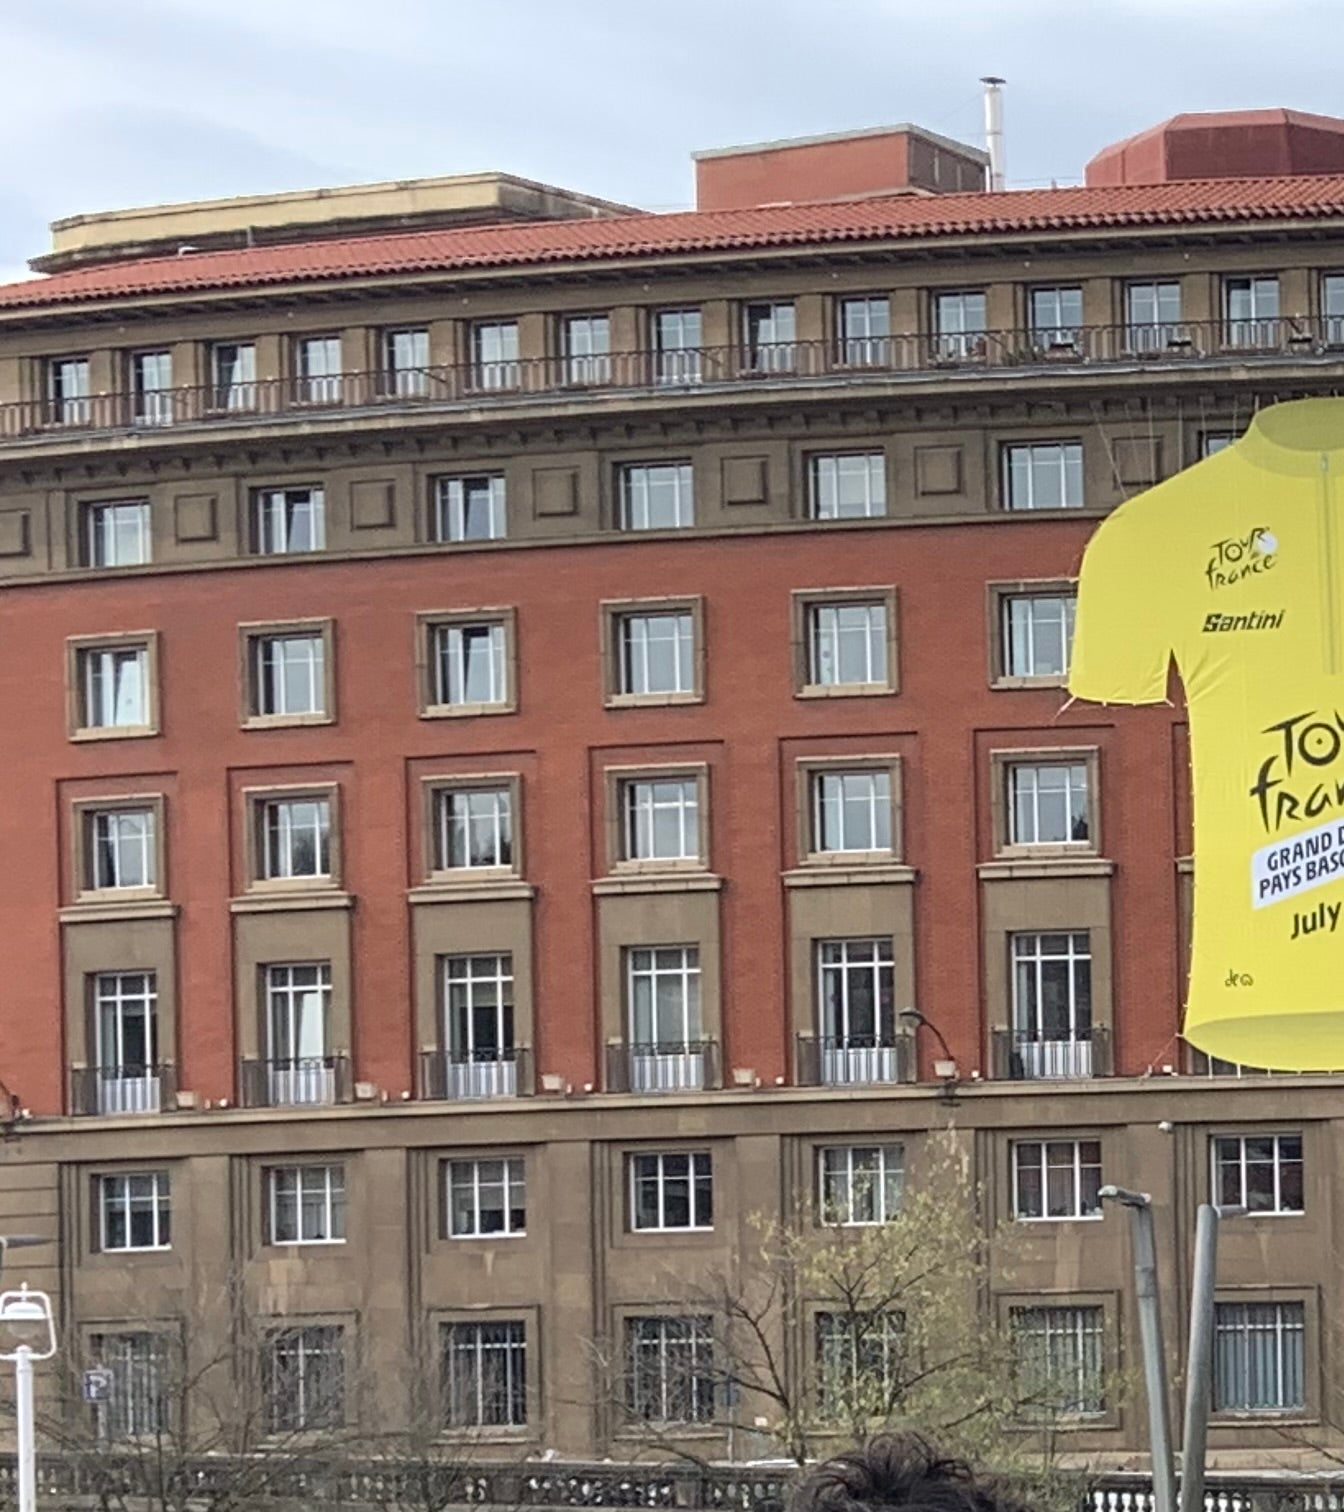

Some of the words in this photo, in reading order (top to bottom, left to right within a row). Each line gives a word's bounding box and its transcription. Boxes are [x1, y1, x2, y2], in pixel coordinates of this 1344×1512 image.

[1202, 609, 1286, 632] Santini
[1266, 832, 1333, 872] GRAND
[1259, 866, 1301, 899] PAYS
[1291, 902, 1342, 940] July
[89, 1375, 107, 1398] P
